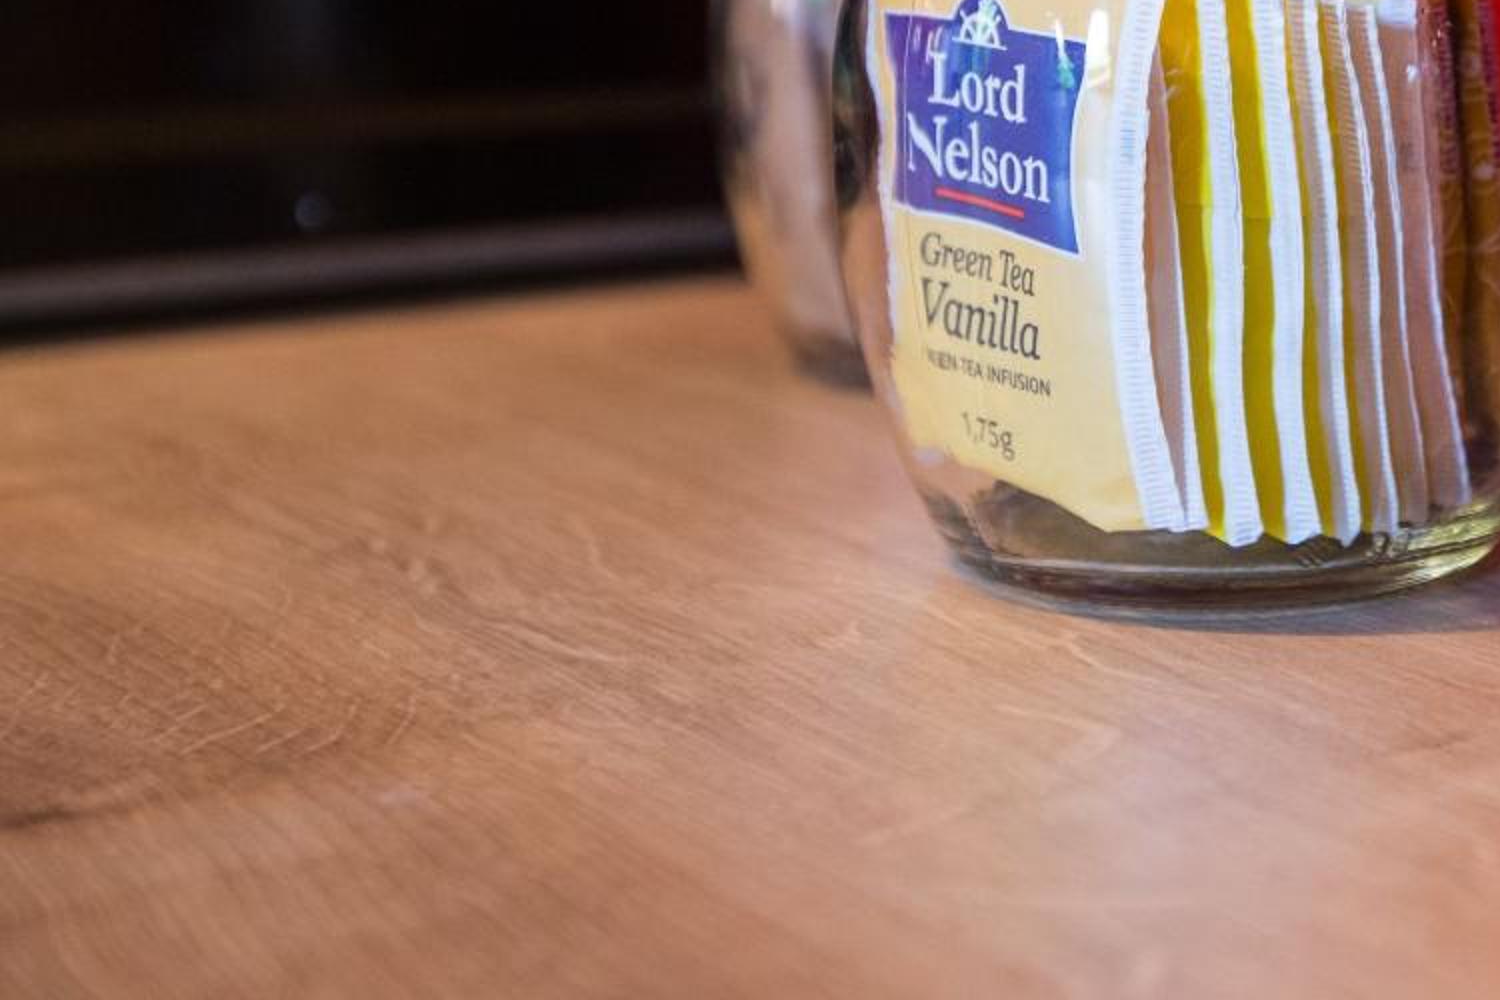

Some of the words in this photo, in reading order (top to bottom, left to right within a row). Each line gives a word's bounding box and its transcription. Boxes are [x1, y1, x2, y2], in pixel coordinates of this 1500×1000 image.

[927, 50, 1027, 124] Lord
[906, 111, 1051, 204] Nelson
[920, 231, 993, 282] Green
[999, 249, 1036, 297] Tea
[920, 276, 1041, 360] Vanilla
[959, 356, 983, 379] TEA
[985, 363, 1052, 397] INFUSION
[961, 410, 1016, 462] 1,75g
